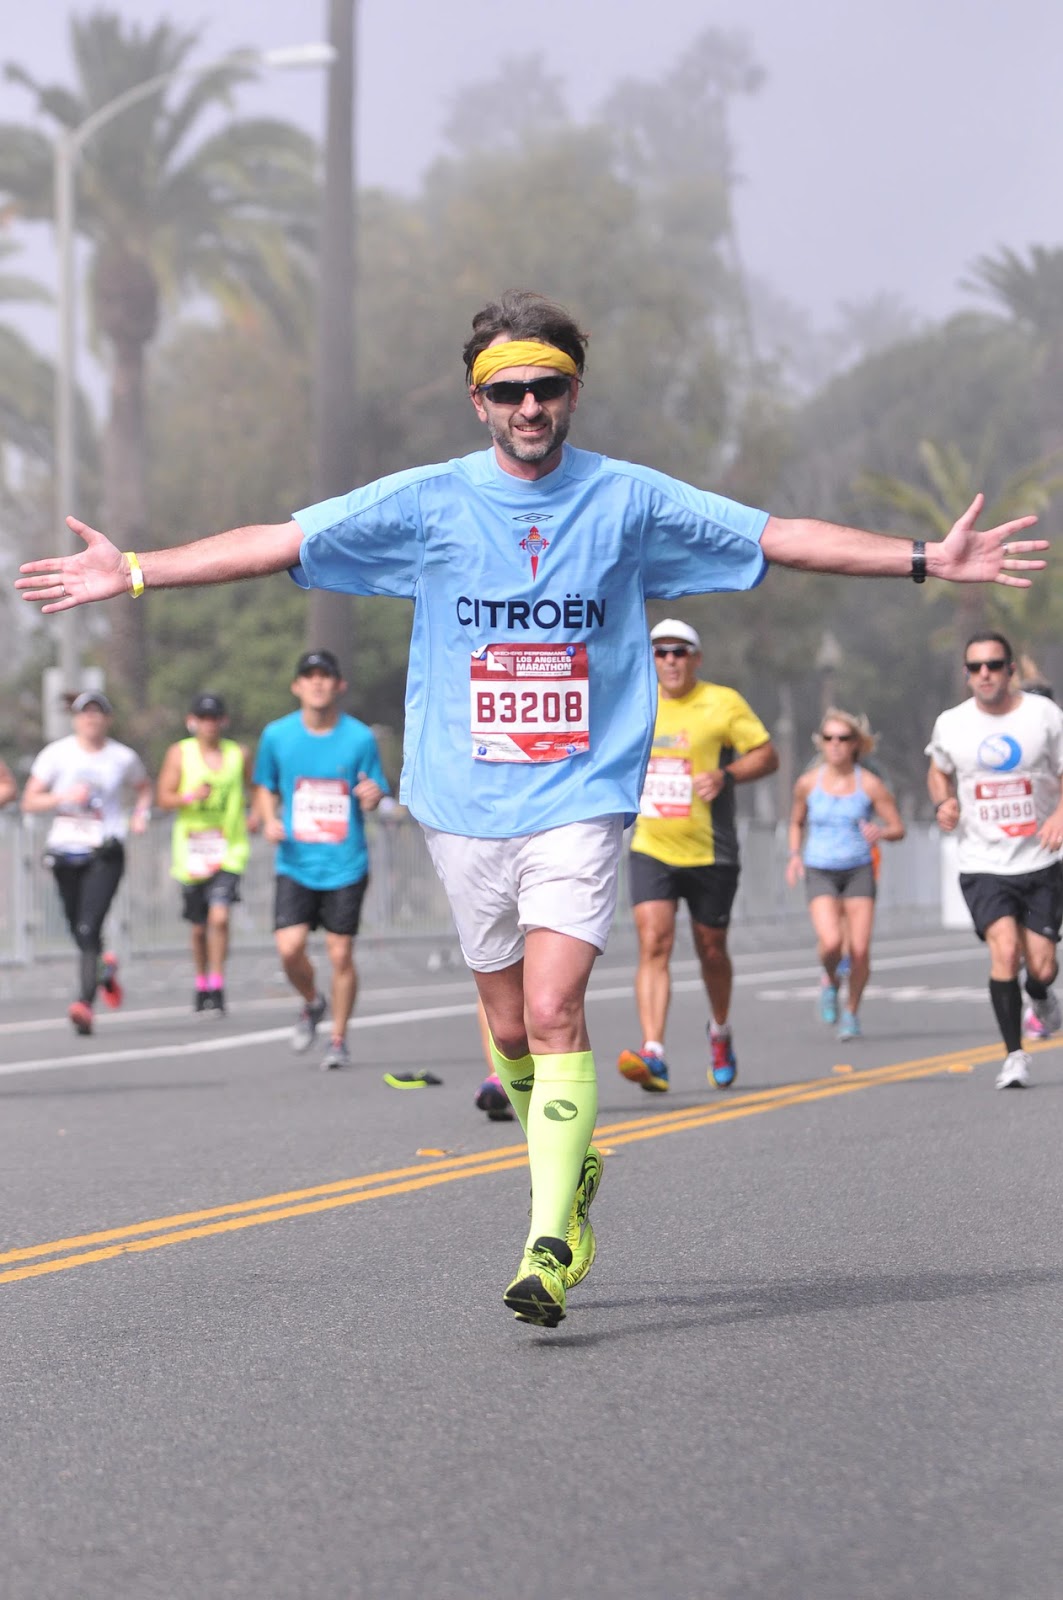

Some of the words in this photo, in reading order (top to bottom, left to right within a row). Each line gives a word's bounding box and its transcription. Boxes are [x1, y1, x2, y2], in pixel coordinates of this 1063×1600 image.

[457, 594, 606, 629] CITROËN
[516, 663, 571, 671] MARATHON
[477, 691, 582, 723] B3208
